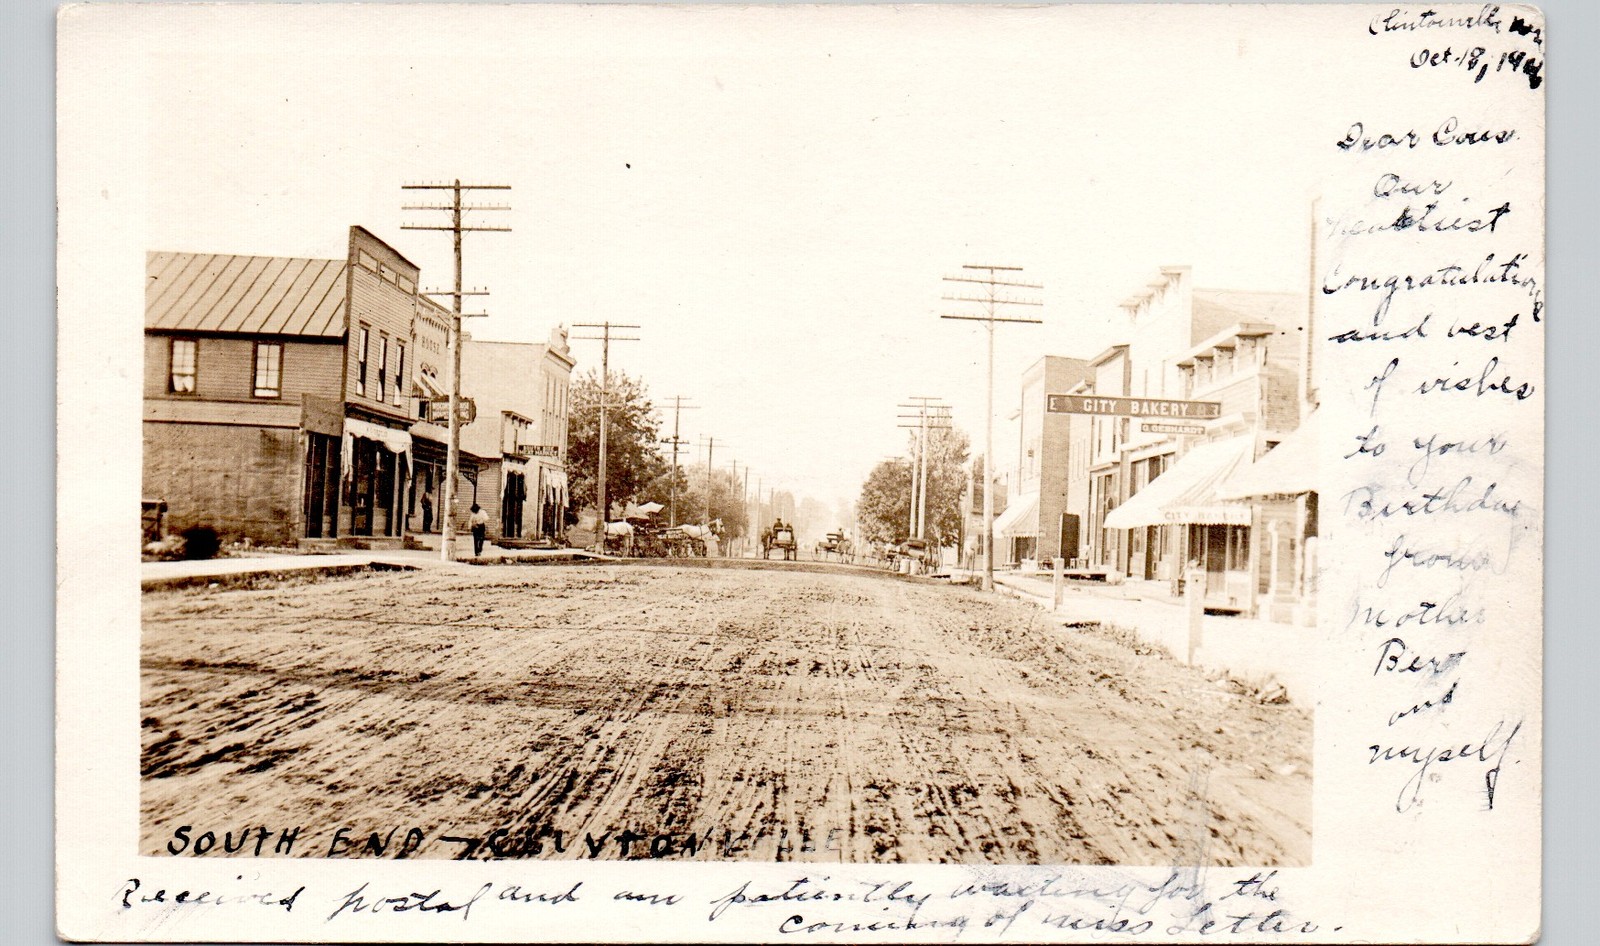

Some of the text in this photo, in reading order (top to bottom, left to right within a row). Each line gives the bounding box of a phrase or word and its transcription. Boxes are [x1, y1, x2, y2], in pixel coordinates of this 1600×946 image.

[1336, 122, 1420, 151] Dear
[1374, 173, 1453, 198] Our
[1328, 312, 1433, 344] and
[1364, 356, 1536, 418] of wishes
[1083, 398, 1189, 416] CITY BAKERY
[1343, 424, 1507, 487] to your
[1164, 511, 1190, 520] CITY
[1387, 678, 1461, 727] and
[326, 882, 493, 921] postal
[498, 882, 583, 905] and
[1219, 870, 1280, 901] the
[983, 900, 1035, 937] of
